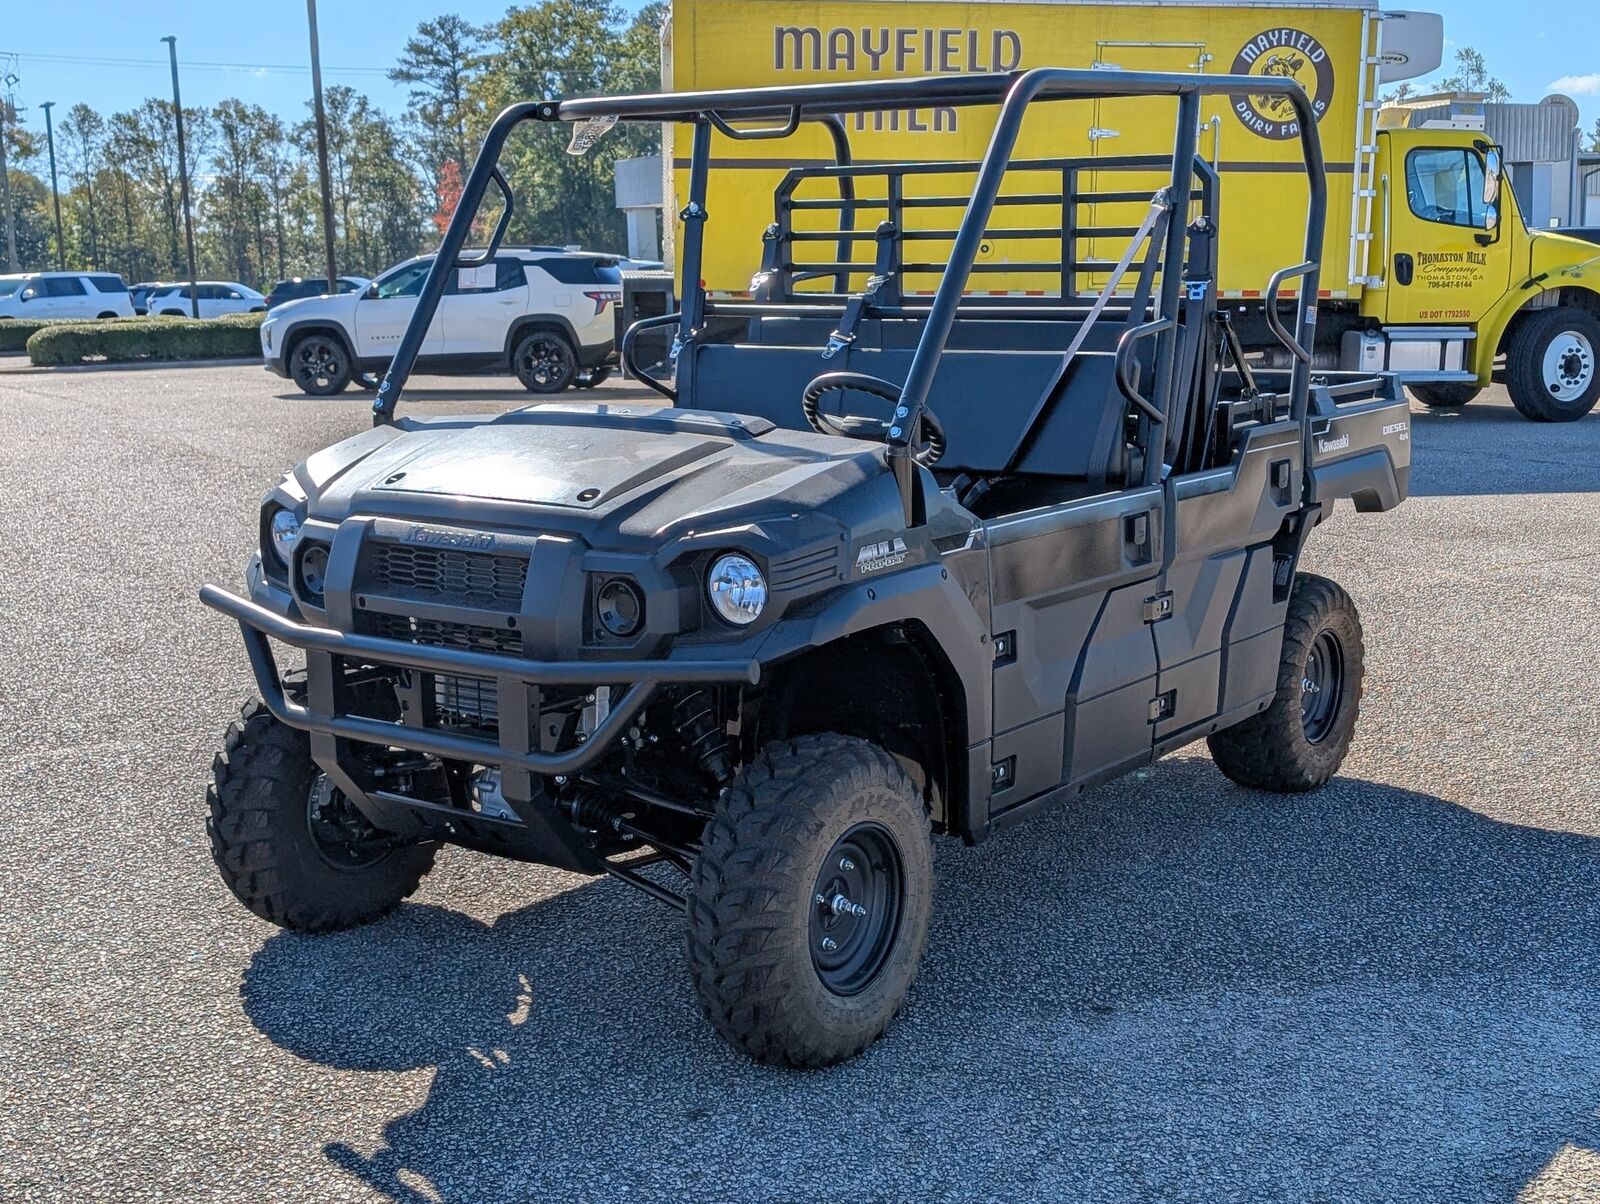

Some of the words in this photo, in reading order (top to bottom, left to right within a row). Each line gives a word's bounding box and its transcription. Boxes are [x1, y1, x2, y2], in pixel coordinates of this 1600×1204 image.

[774, 26, 1022, 73] MAYFIELD
[1240, 29, 1326, 63] MAYFIELD
[1236, 101, 1273, 134] DAIRY
[1281, 100, 1325, 136] FAS
[1417, 252, 1464, 266] THOMASTON
[1466, 251, 1487, 266] MILK
[1422, 264, 1478, 275] Company
[1419, 311, 1428, 319] US
[1382, 421, 1408, 435] DIESEL
[1318, 434, 1350, 454] Kawasaki
[405, 523, 495, 550] Kawasaki
[856, 537, 909, 568] MULE
